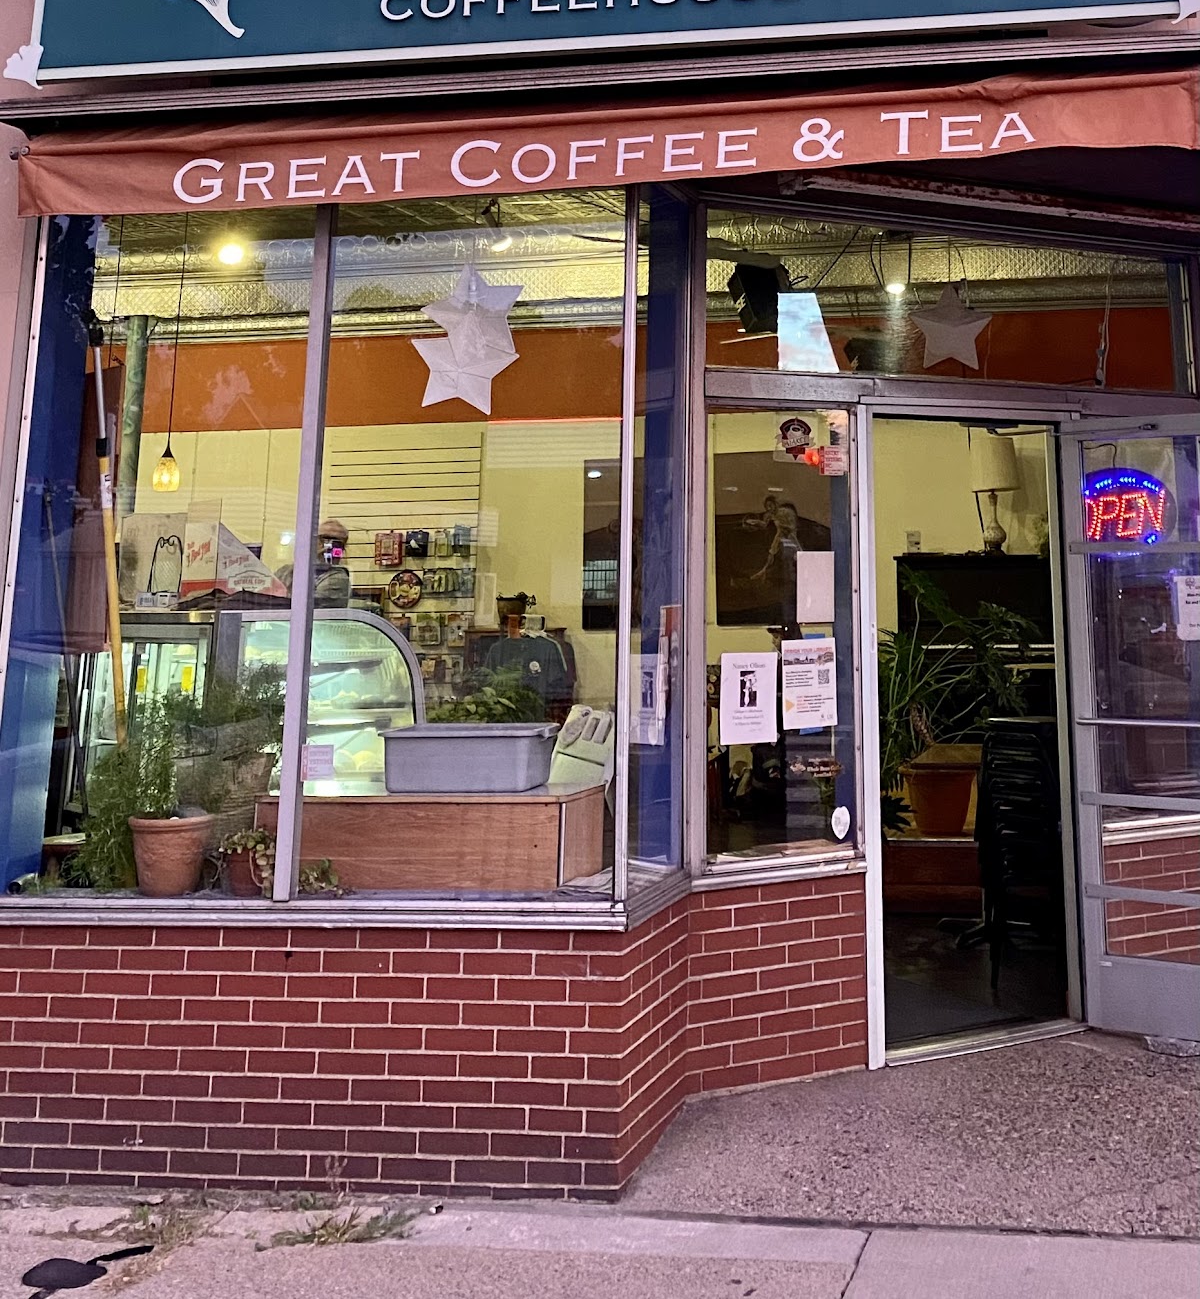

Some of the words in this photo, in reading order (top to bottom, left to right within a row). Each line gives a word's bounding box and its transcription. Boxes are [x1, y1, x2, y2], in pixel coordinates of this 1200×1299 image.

[172, 149, 420, 204] GREAT
[450, 127, 758, 187] COFFEE
[792, 117, 845, 163] &
[880, 109, 1036, 155] TEA
